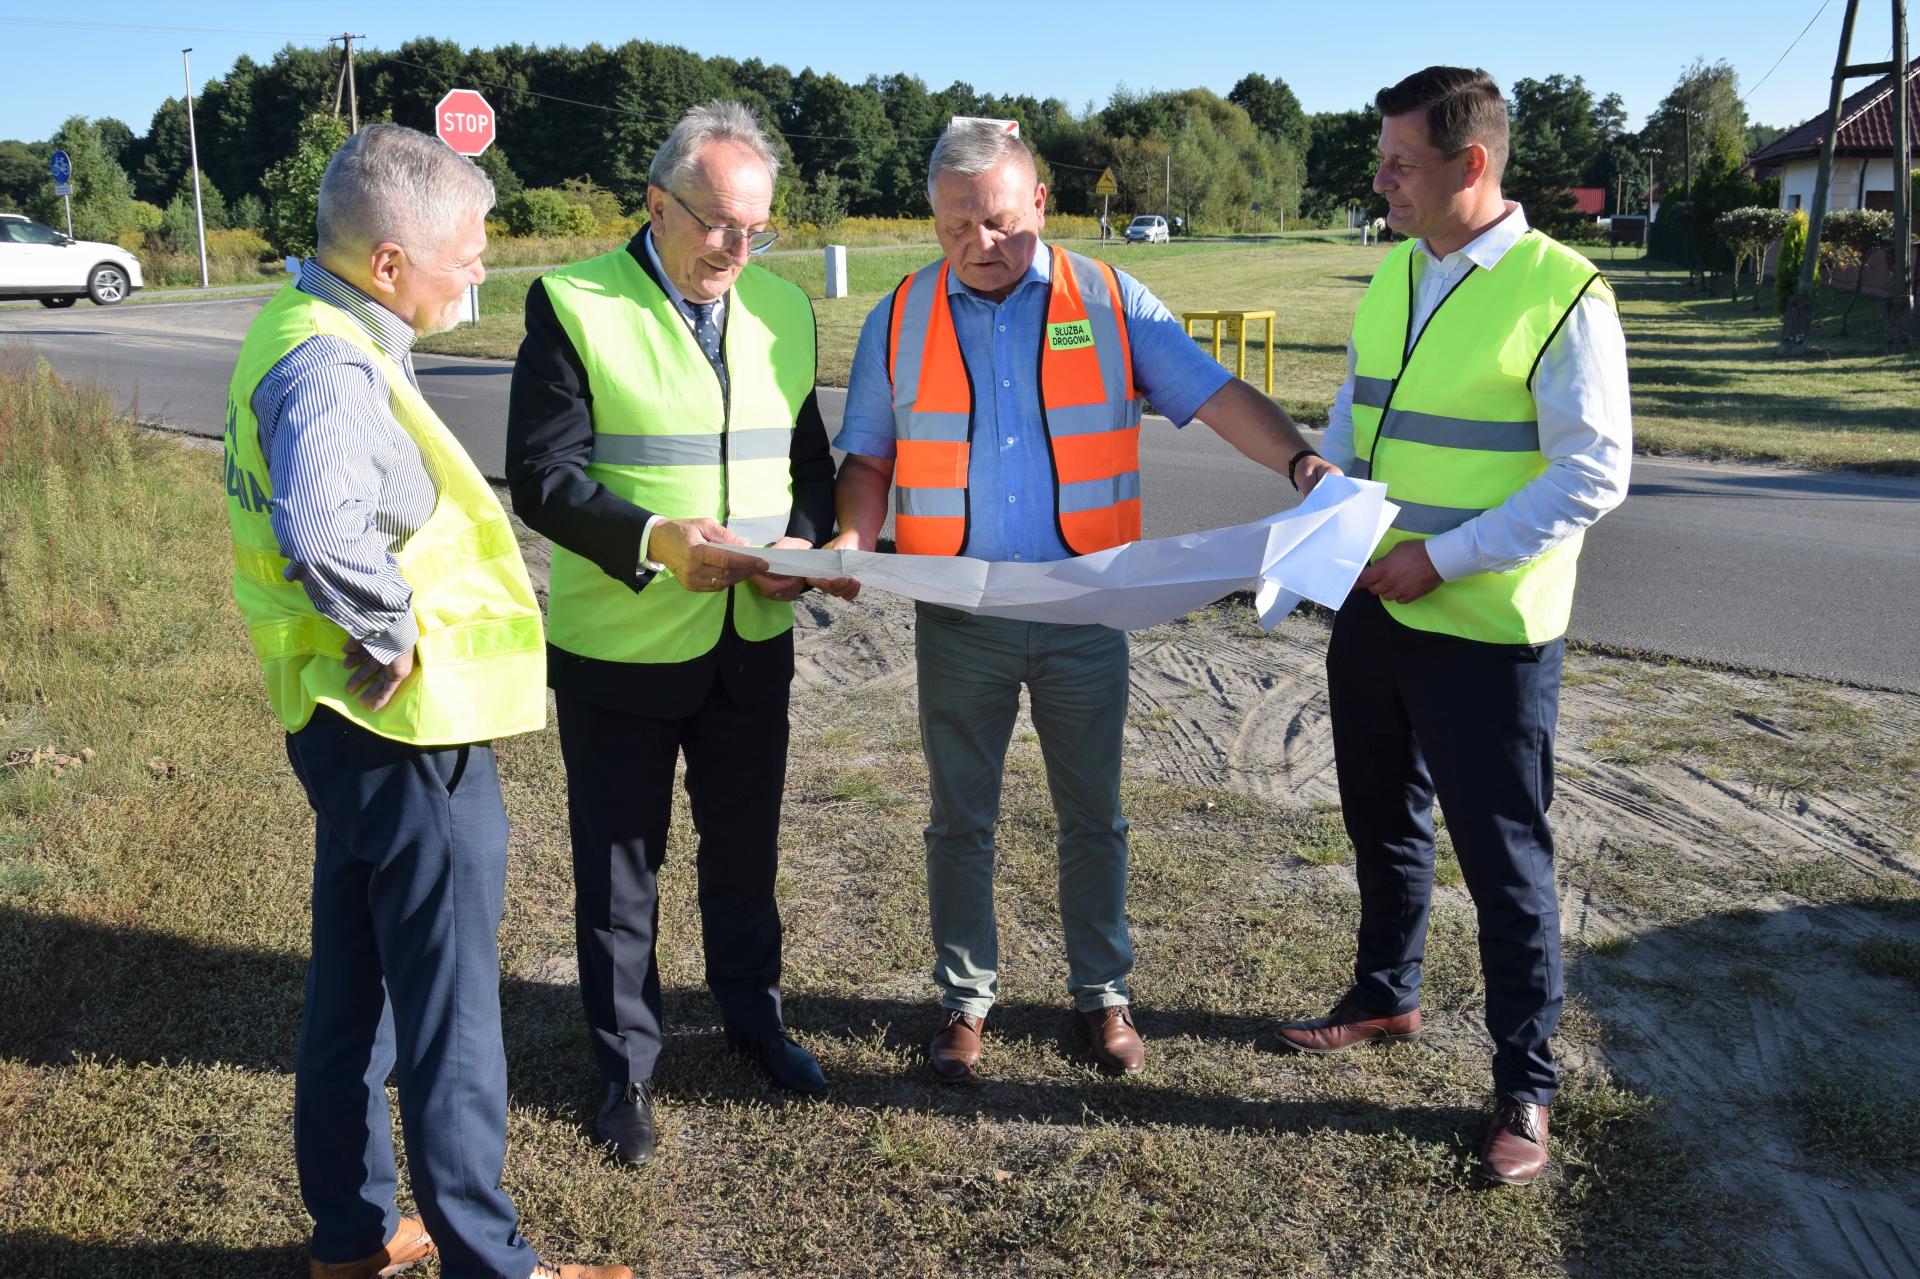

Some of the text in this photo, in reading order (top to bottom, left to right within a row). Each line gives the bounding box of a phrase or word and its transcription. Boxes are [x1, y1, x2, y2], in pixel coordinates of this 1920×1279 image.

[444, 112, 489, 133] STOP
[1054, 325, 1085, 336] SŁUŻBA
[1052, 334, 1091, 346] DROGOWA
